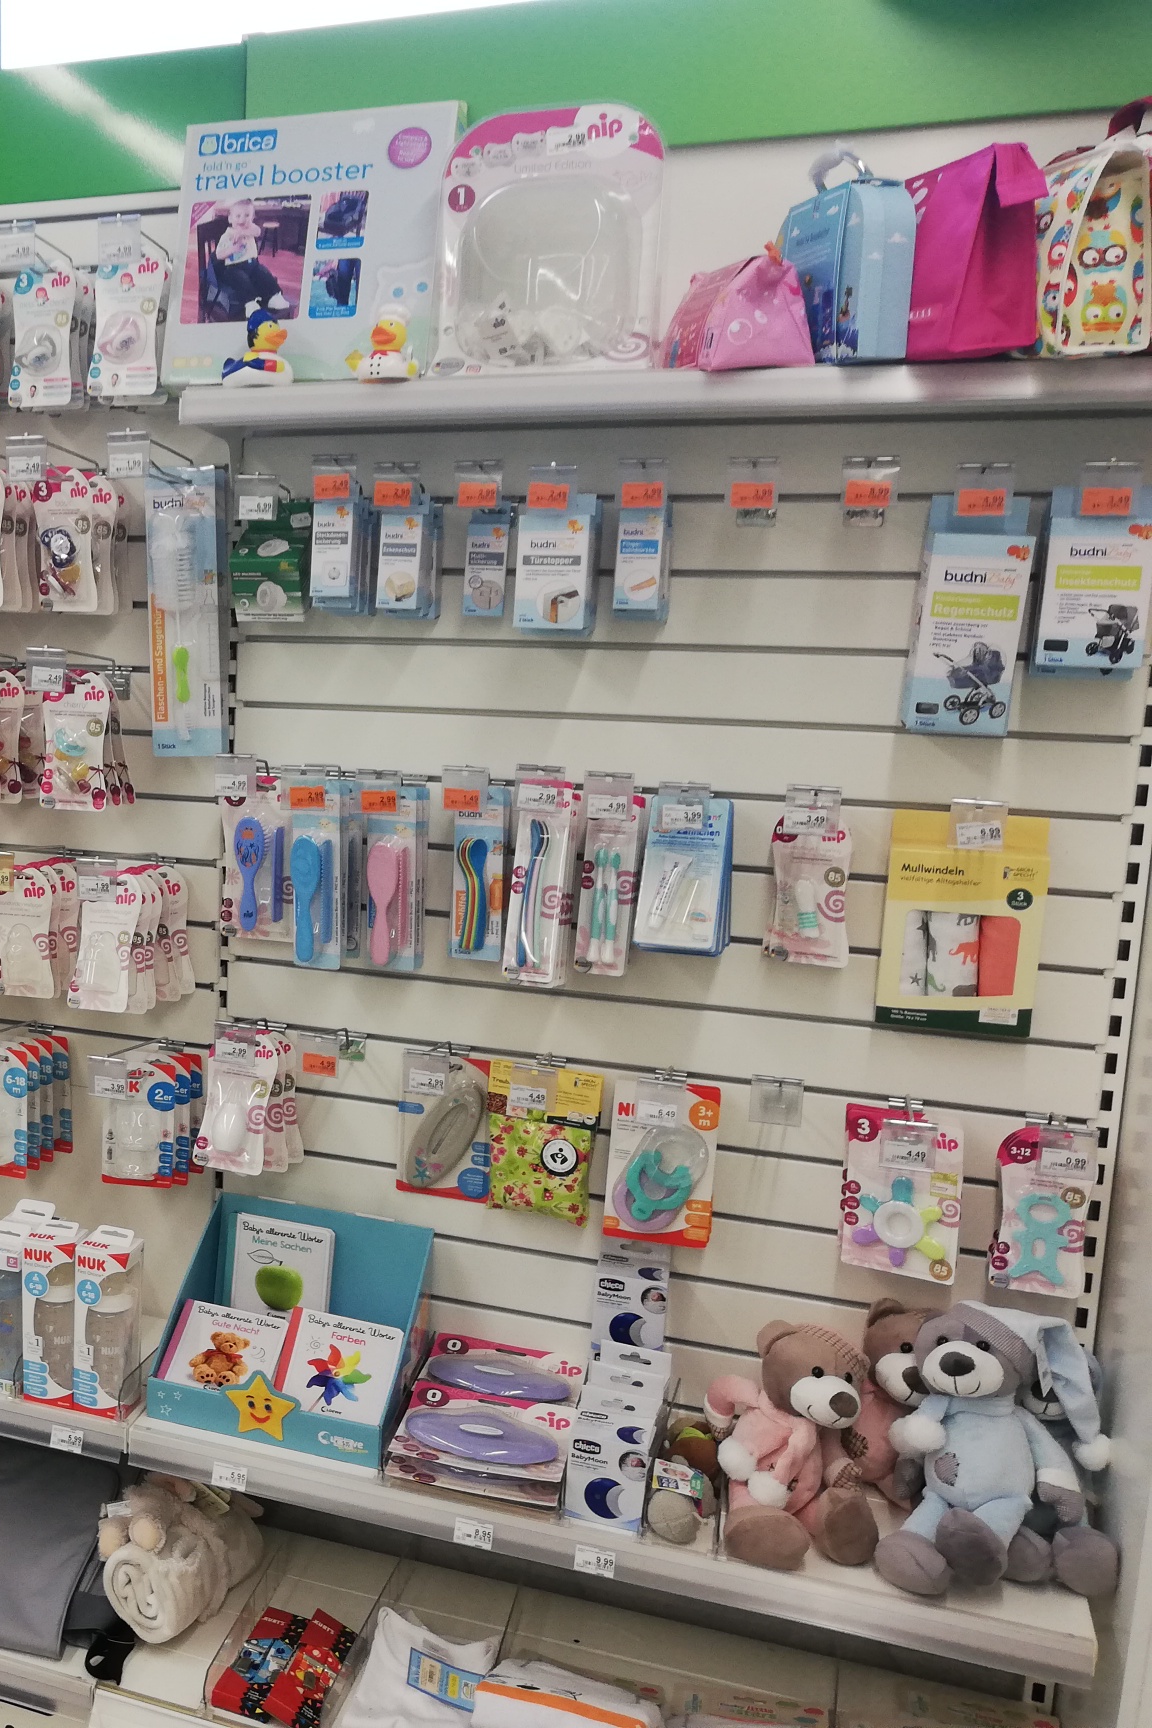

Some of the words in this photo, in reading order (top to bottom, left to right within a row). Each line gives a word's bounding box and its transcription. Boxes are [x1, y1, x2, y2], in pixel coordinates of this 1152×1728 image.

[588, 113, 622, 139] nip
[224, 133, 275, 153] brica
[194, 166, 264, 191] travel
[272, 161, 374, 185] booster
[138, 258, 159, 274] nip
[52, 272, 71, 288] nip
[25, 462, 40, 470] 2.49
[38, 482, 47, 496] 3
[70, 482, 88, 498] nip
[92, 488, 112, 504] nip
[530, 540, 557, 549] budni
[1070, 546, 1107, 557] budni
[530, 556, 574, 565] Türstopper
[944, 570, 988, 584] budni
[1059, 576, 1138, 589] Insektenschutz
[933, 604, 1014, 619] Regenschutz
[0, 683, 20, 698] nip
[84, 686, 105, 701] nip
[157, 677, 165, 720] Flaschen-
[231, 780, 246, 788] 4.99
[538, 792, 556, 801] 2.99
[608, 802, 626, 810] 4.99
[684, 811, 702, 821] 3.99
[806, 814, 825, 824] 3.49
[901, 863, 965, 876] Mullwindeln
[828, 872, 842, 883] 85
[24, 882, 46, 898] nip
[6, 1074, 26, 1087] 6-18
[154, 1088, 173, 1103] 2er
[528, 1092, 546, 1102] 4.49
[657, 1108, 676, 1119] 6.49
[698, 1106, 715, 1117] 3+
[856, 1119, 871, 1136] 3
[905, 1150, 926, 1160] 4.49
[1065, 1157, 1086, 1167] 0.99
[1065, 1192, 1082, 1203] 85
[242, 1221, 264, 1236] Babys
[29, 1232, 55, 1241] NUK
[82, 1240, 110, 1250] NUK
[252, 1235, 278, 1248] Meine
[280, 1241, 312, 1254] Sachen
[24, 1248, 53, 1263] NUK
[77, 1255, 106, 1272] NUK
[932, 1263, 948, 1276] 85
[600, 1280, 624, 1290] chicco
[597, 1290, 632, 1301] BabyMoon
[198, 1306, 219, 1317] Babys
[212, 1319, 232, 1331] Gute
[233, 1323, 260, 1336] Nacht
[308, 1314, 330, 1328] Babys
[331, 1331, 366, 1346] Farben
[574, 1440, 600, 1453] chicco
[570, 1453, 608, 1465] BabyMoon
[230, 1471, 246, 1481] 5.95
[474, 1529, 492, 1540] 8.95
[596, 1556, 614, 1567] 9.99
